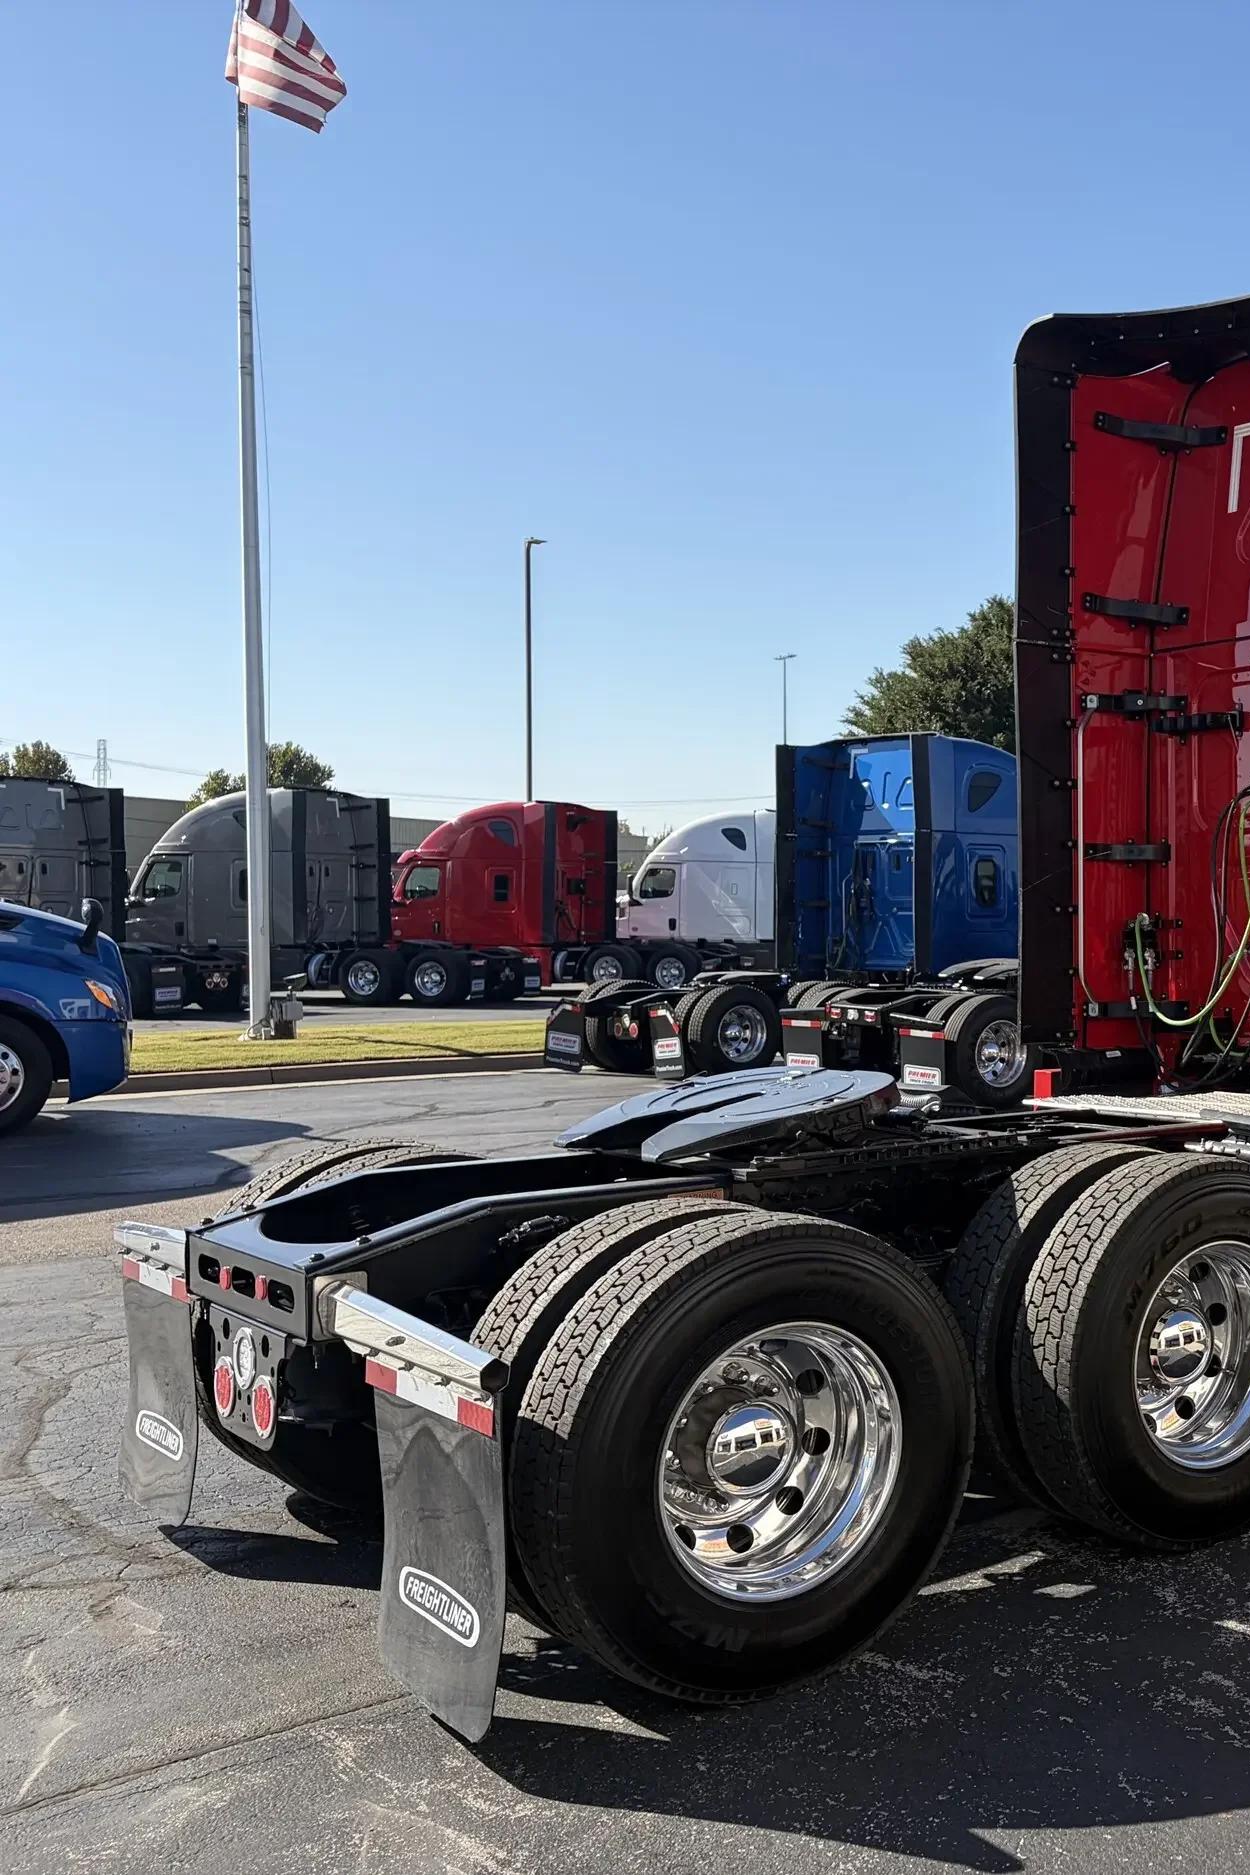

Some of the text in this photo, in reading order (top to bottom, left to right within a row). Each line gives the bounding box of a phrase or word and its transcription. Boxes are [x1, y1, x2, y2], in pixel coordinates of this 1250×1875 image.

[790, 1058, 816, 1066] PREMIER
[908, 1070, 936, 1079] PREMIER
[140, 1417, 180, 1453] FREIGHTLINER
[405, 1576, 473, 1636] FREIGHTLINER
